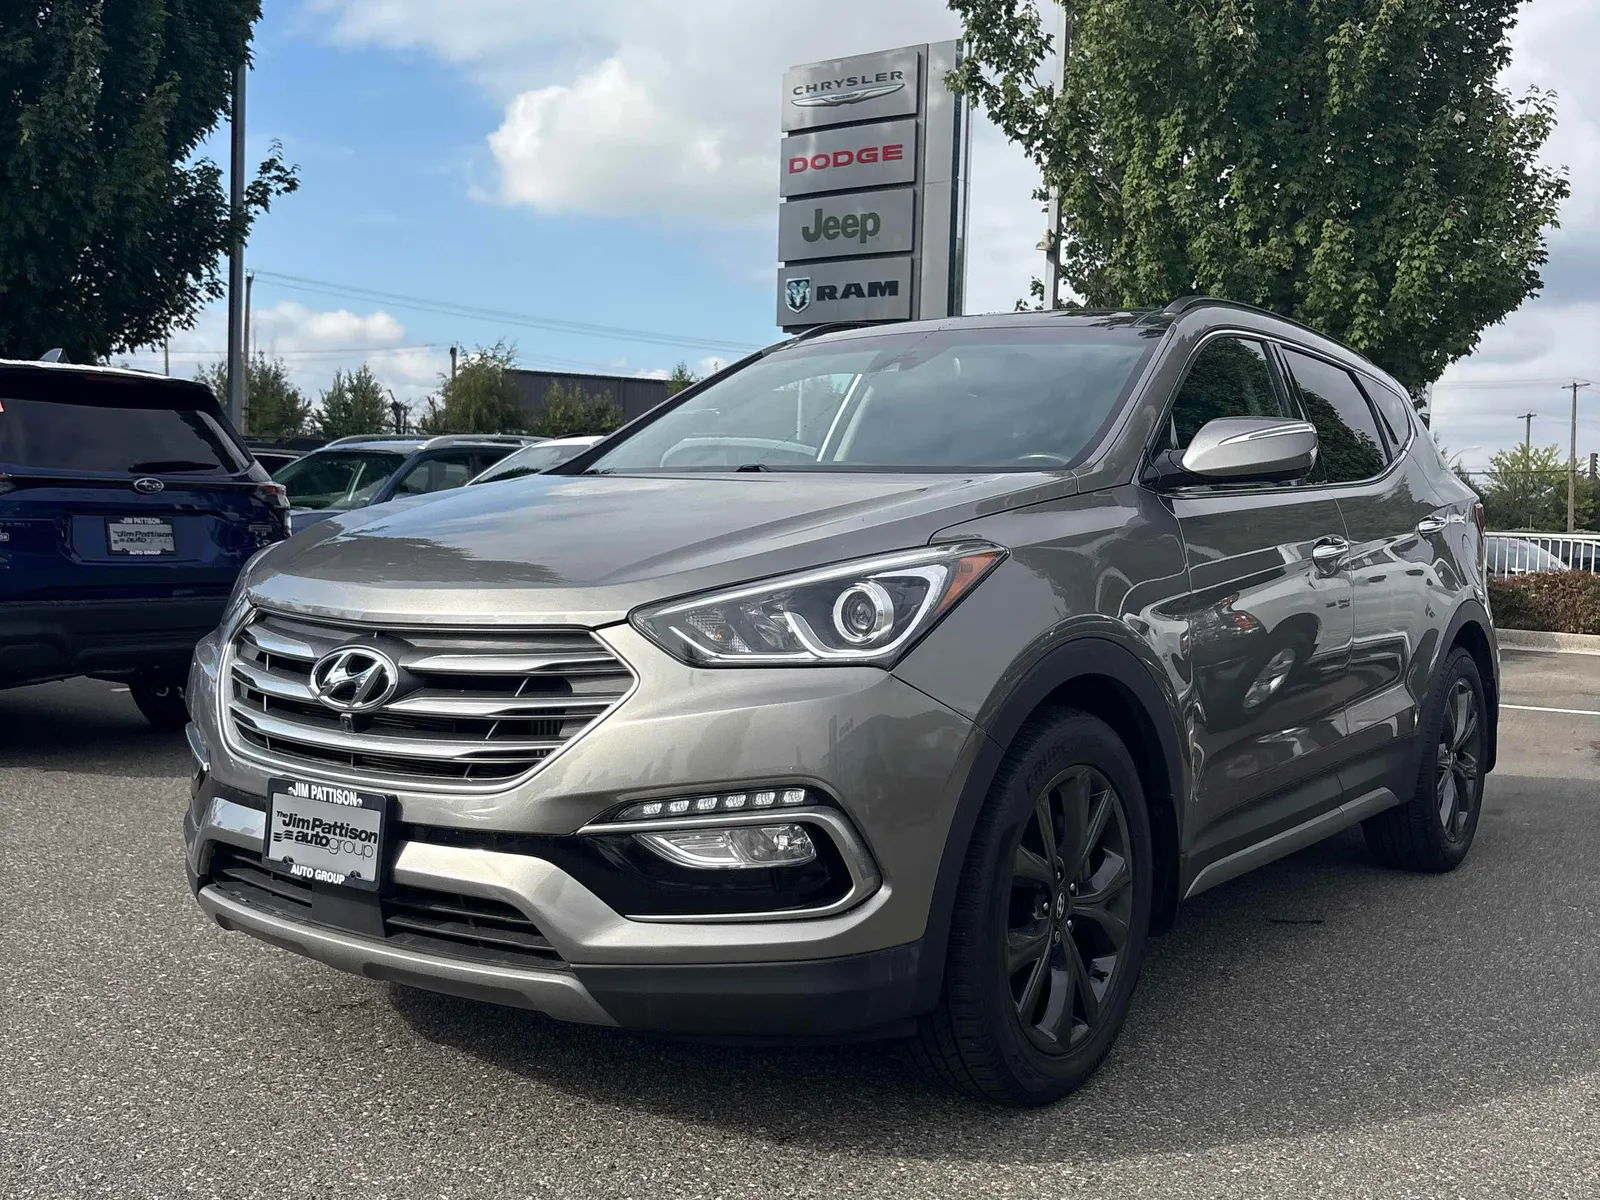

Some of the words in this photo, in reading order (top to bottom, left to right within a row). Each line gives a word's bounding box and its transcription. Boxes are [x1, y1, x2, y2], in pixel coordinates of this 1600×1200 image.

[792, 70, 904, 96] CHRYSLER
[788, 144, 904, 174] DODGE
[802, 208, 881, 244] Jeep
[816, 280, 899, 301] RAM
[293, 782, 309, 798] JIM
[311, 784, 357, 807] PATTISON
[276, 810, 289, 818] The
[290, 864, 314, 879] AUTO
[314, 870, 346, 885] GROUP
